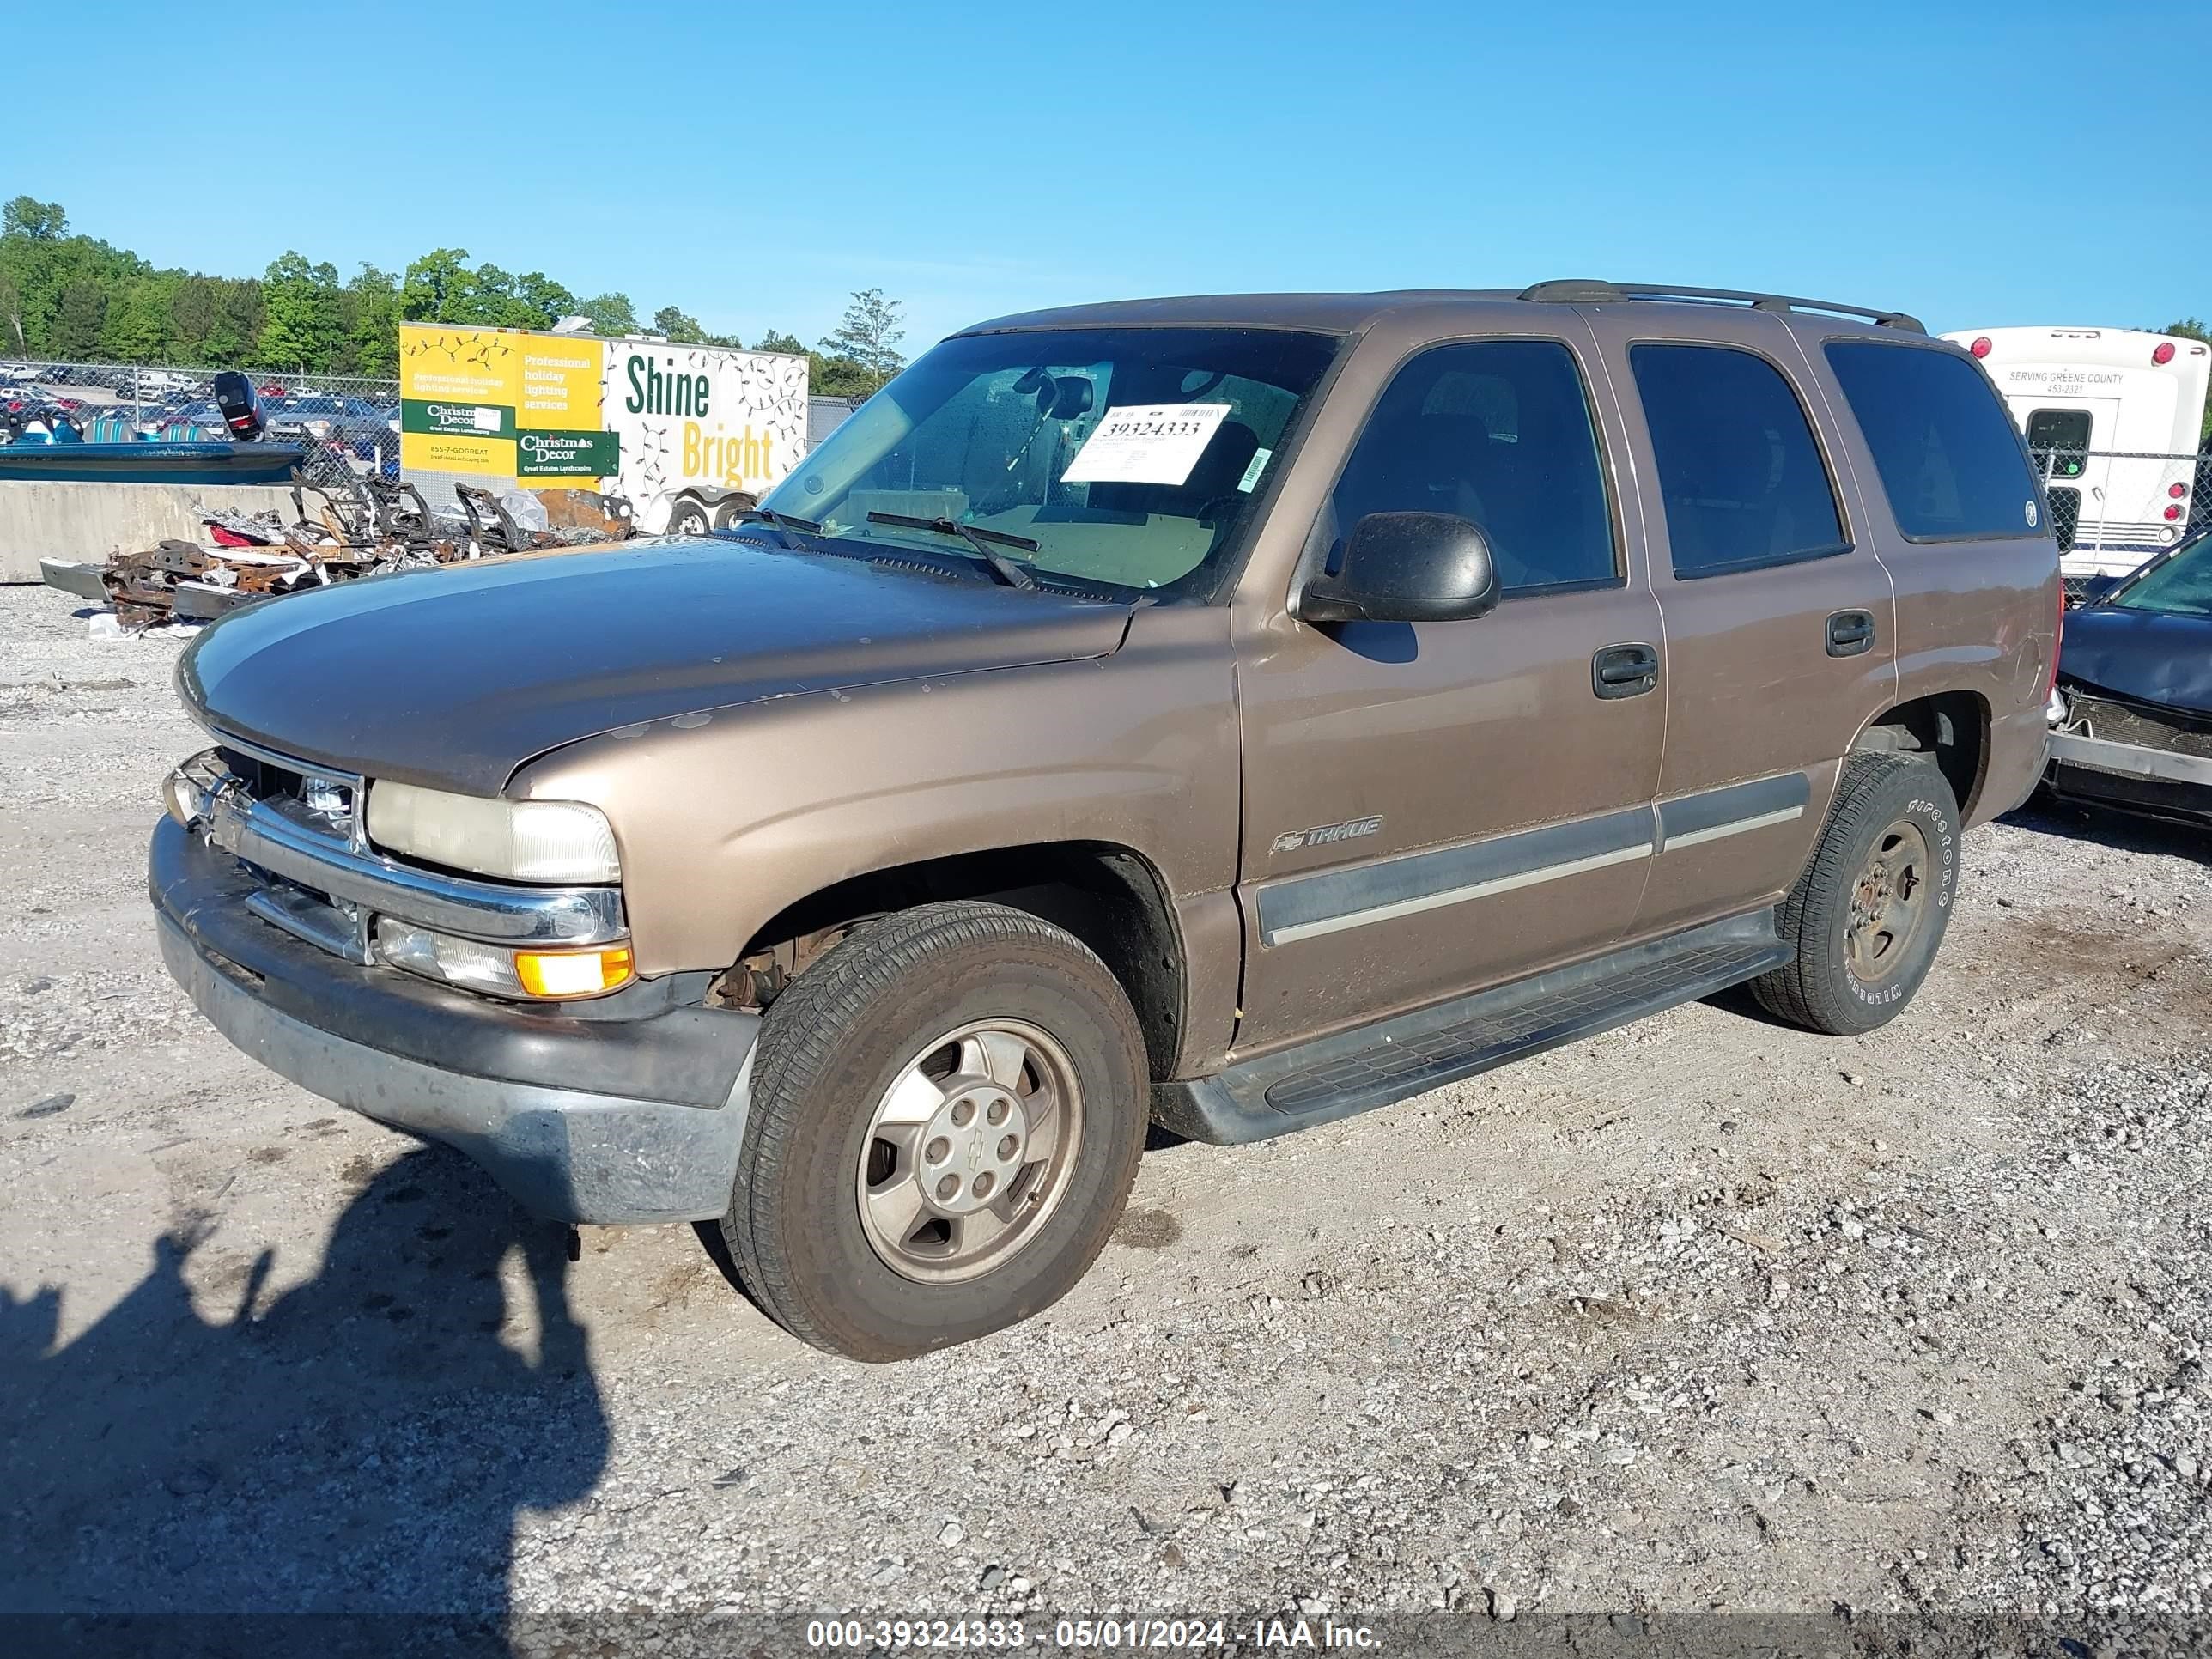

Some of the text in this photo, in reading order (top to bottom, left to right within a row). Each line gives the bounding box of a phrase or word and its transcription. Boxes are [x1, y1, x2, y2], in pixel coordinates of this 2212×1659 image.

[524, 355, 590, 368] Professional
[414, 373, 503, 387] Professional holiday
[524, 370, 564, 384] holiday
[2009, 372, 2124, 384] SERVING GREENE COUNTY
[414, 382, 488, 395] lighting services
[524, 384, 568, 398] lighting
[626, 355, 709, 417] Shine
[2047, 385, 2083, 393] 453-2321
[427, 404, 475, 416] Christm
[524, 400, 568, 410] services
[440, 414, 475, 425] Decor
[1103, 422, 1201, 436] 39324333
[520, 434, 592, 451] Christmas
[430, 446, 488, 455] 855-7-GOGREAT
[536, 448, 576, 462] Decor
[683, 421, 773, 489] Bright
[1308, 818, 1382, 846] TAHOE
